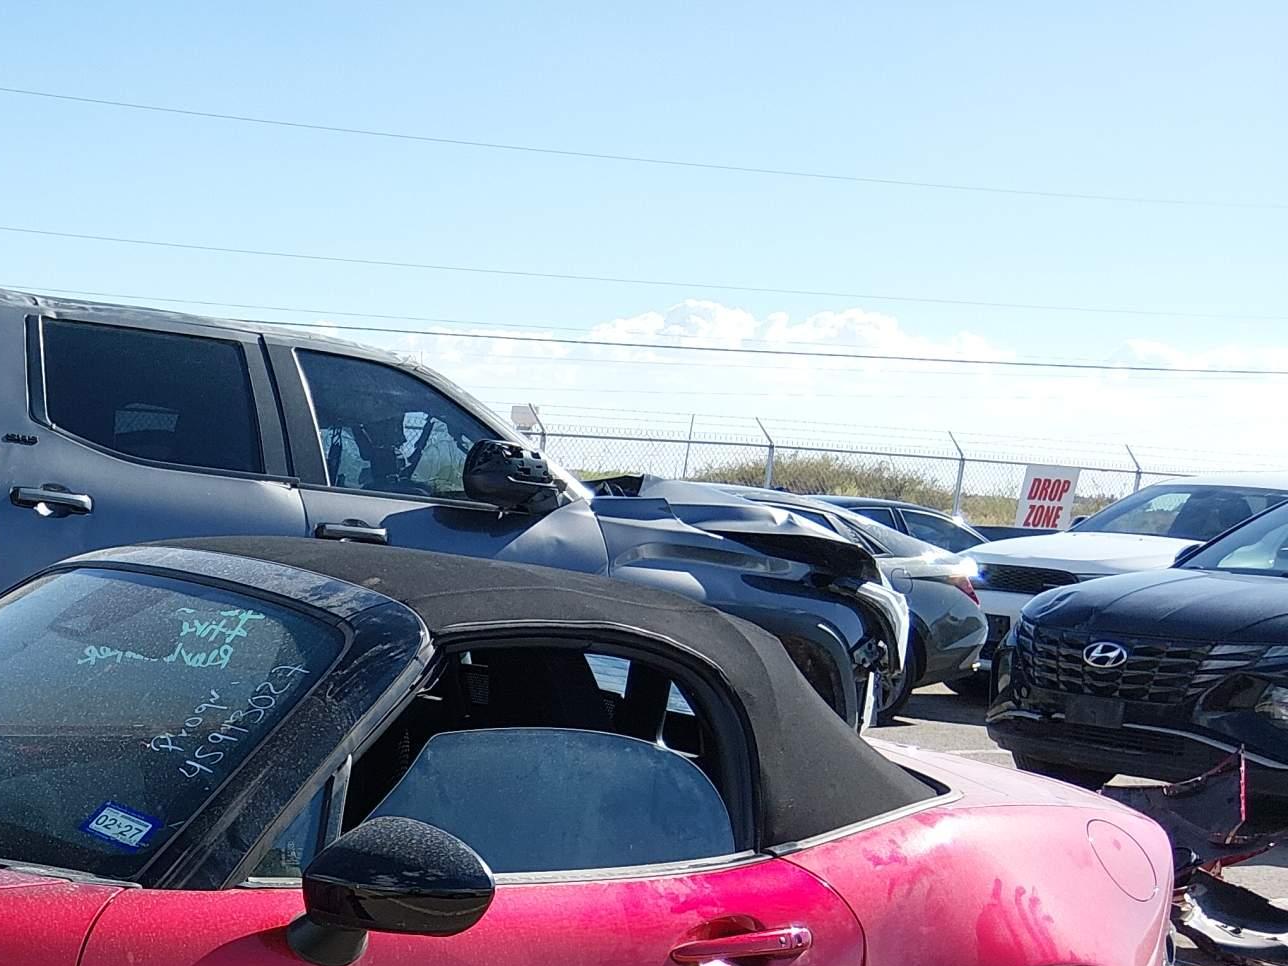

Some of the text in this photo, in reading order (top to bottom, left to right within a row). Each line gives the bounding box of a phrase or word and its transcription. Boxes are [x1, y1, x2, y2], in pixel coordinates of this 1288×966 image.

[1027, 477, 1072, 502] DROP
[1022, 504, 1064, 528] ZONE
[178, 664, 311, 778] 45913027
